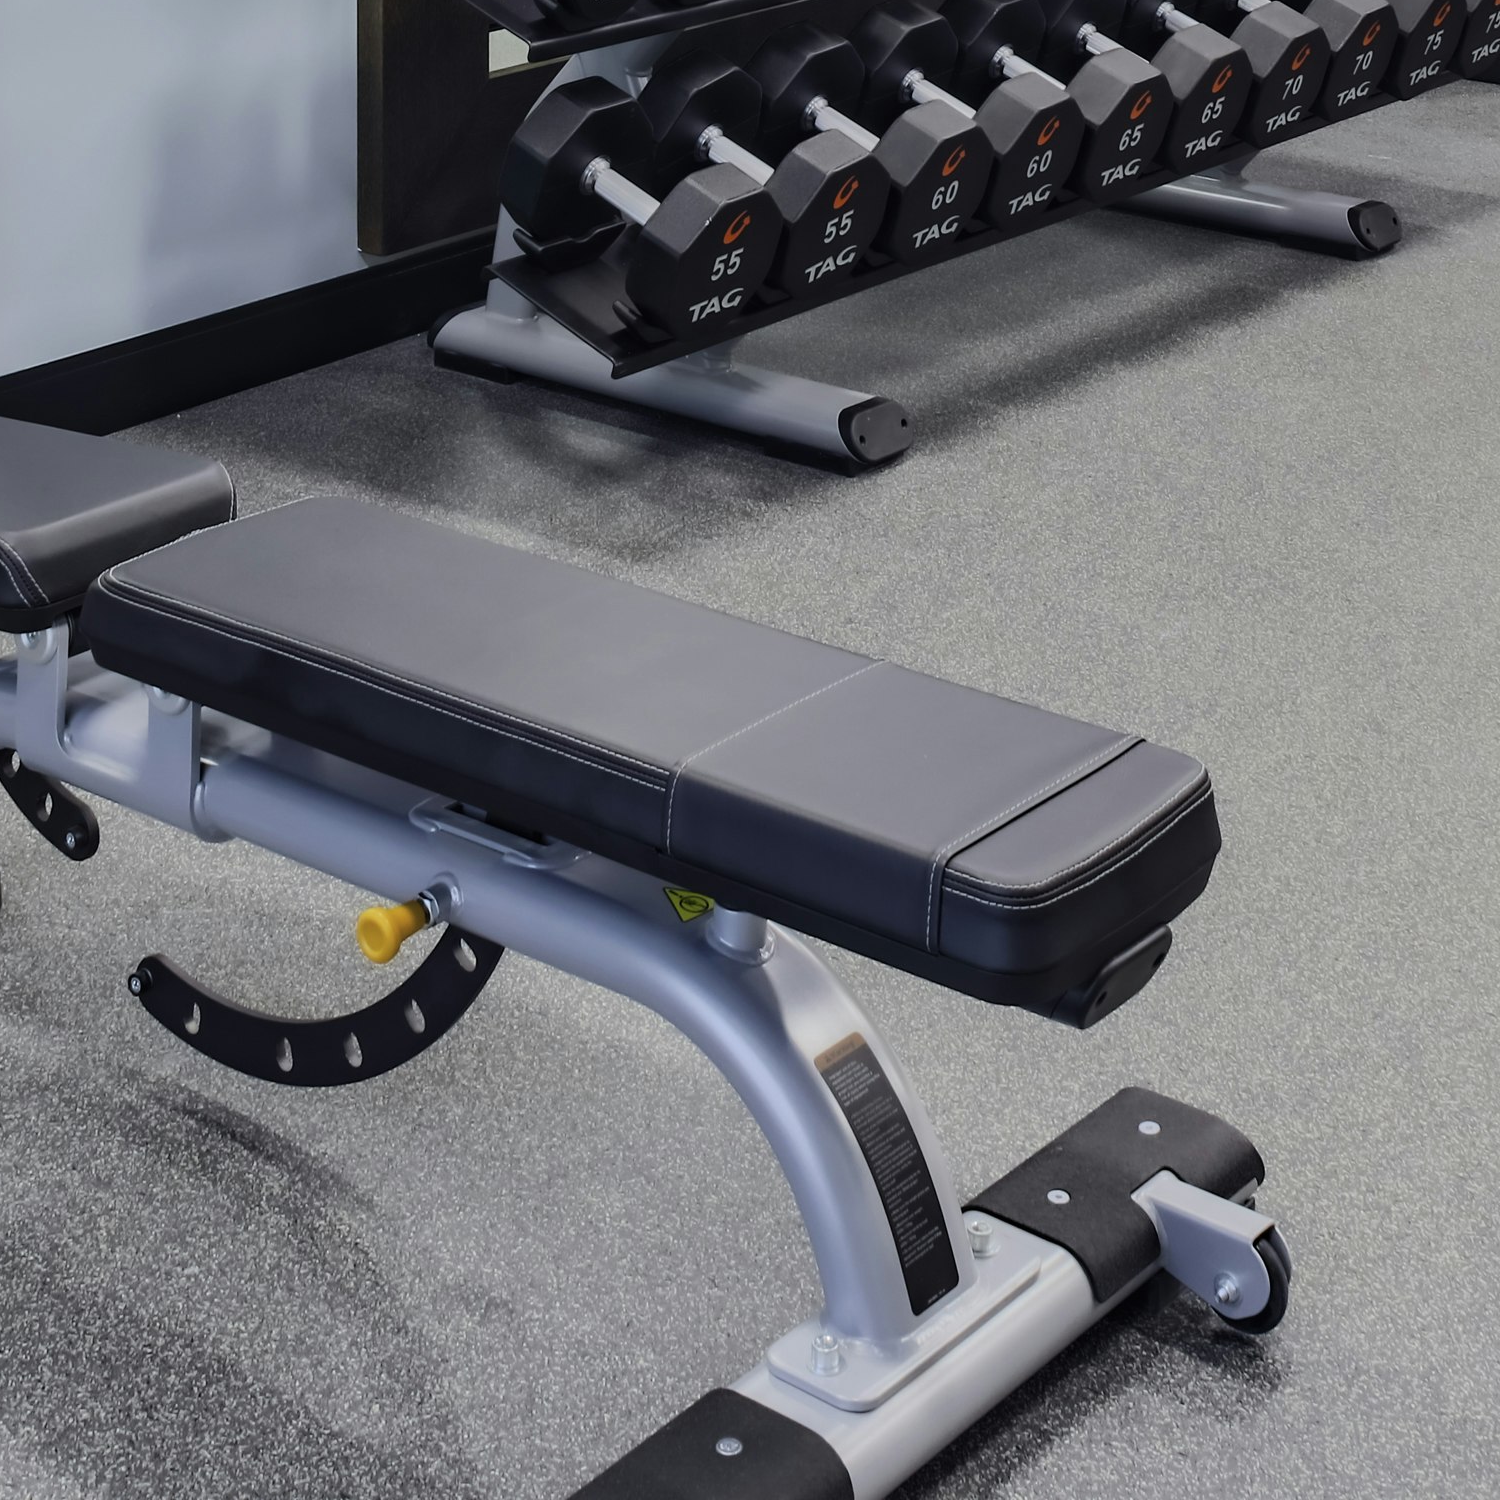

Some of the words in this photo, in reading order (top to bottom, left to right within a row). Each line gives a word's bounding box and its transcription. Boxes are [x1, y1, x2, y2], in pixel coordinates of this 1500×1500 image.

[1424, 29, 1444, 55] 75
[1353, 51, 1373, 75] 70
[1409, 60, 1442, 86] TAG
[1283, 75, 1303, 100] 70
[1337, 81, 1370, 107] TAG
[1201, 96, 1226, 124] 65
[1266, 105, 1301, 133] TAG
[1119, 123, 1144, 151] 65
[1185, 130, 1223, 158] TAG
[1027, 150, 1052, 178] 60
[1101, 158, 1141, 186] TAG
[931, 180, 959, 210] 60
[1009, 184, 1052, 214] TAG
[824, 210, 854, 243] 55
[912, 215, 960, 248] TAG
[711, 247, 744, 281] 55
[805, 245, 857, 283] TAG
[689, 288, 744, 322] TAG
